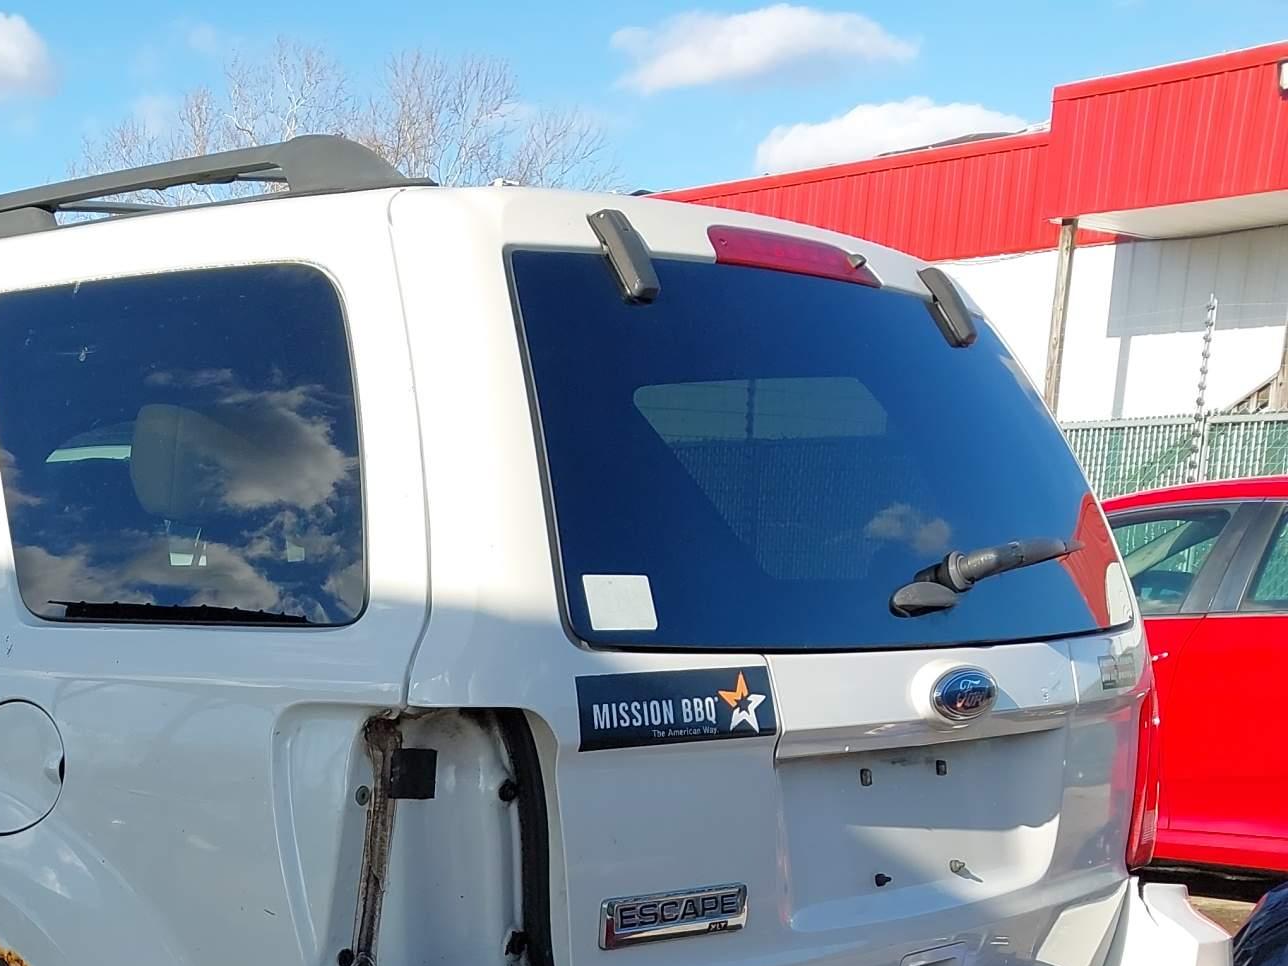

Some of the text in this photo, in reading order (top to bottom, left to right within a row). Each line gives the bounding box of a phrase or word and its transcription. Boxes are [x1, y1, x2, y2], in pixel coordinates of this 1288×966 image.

[592, 696, 717, 730] MISSION BBQ
[652, 729, 665, 738] The
[667, 727, 702, 737] American
[618, 893, 738, 929] ESCAPE
